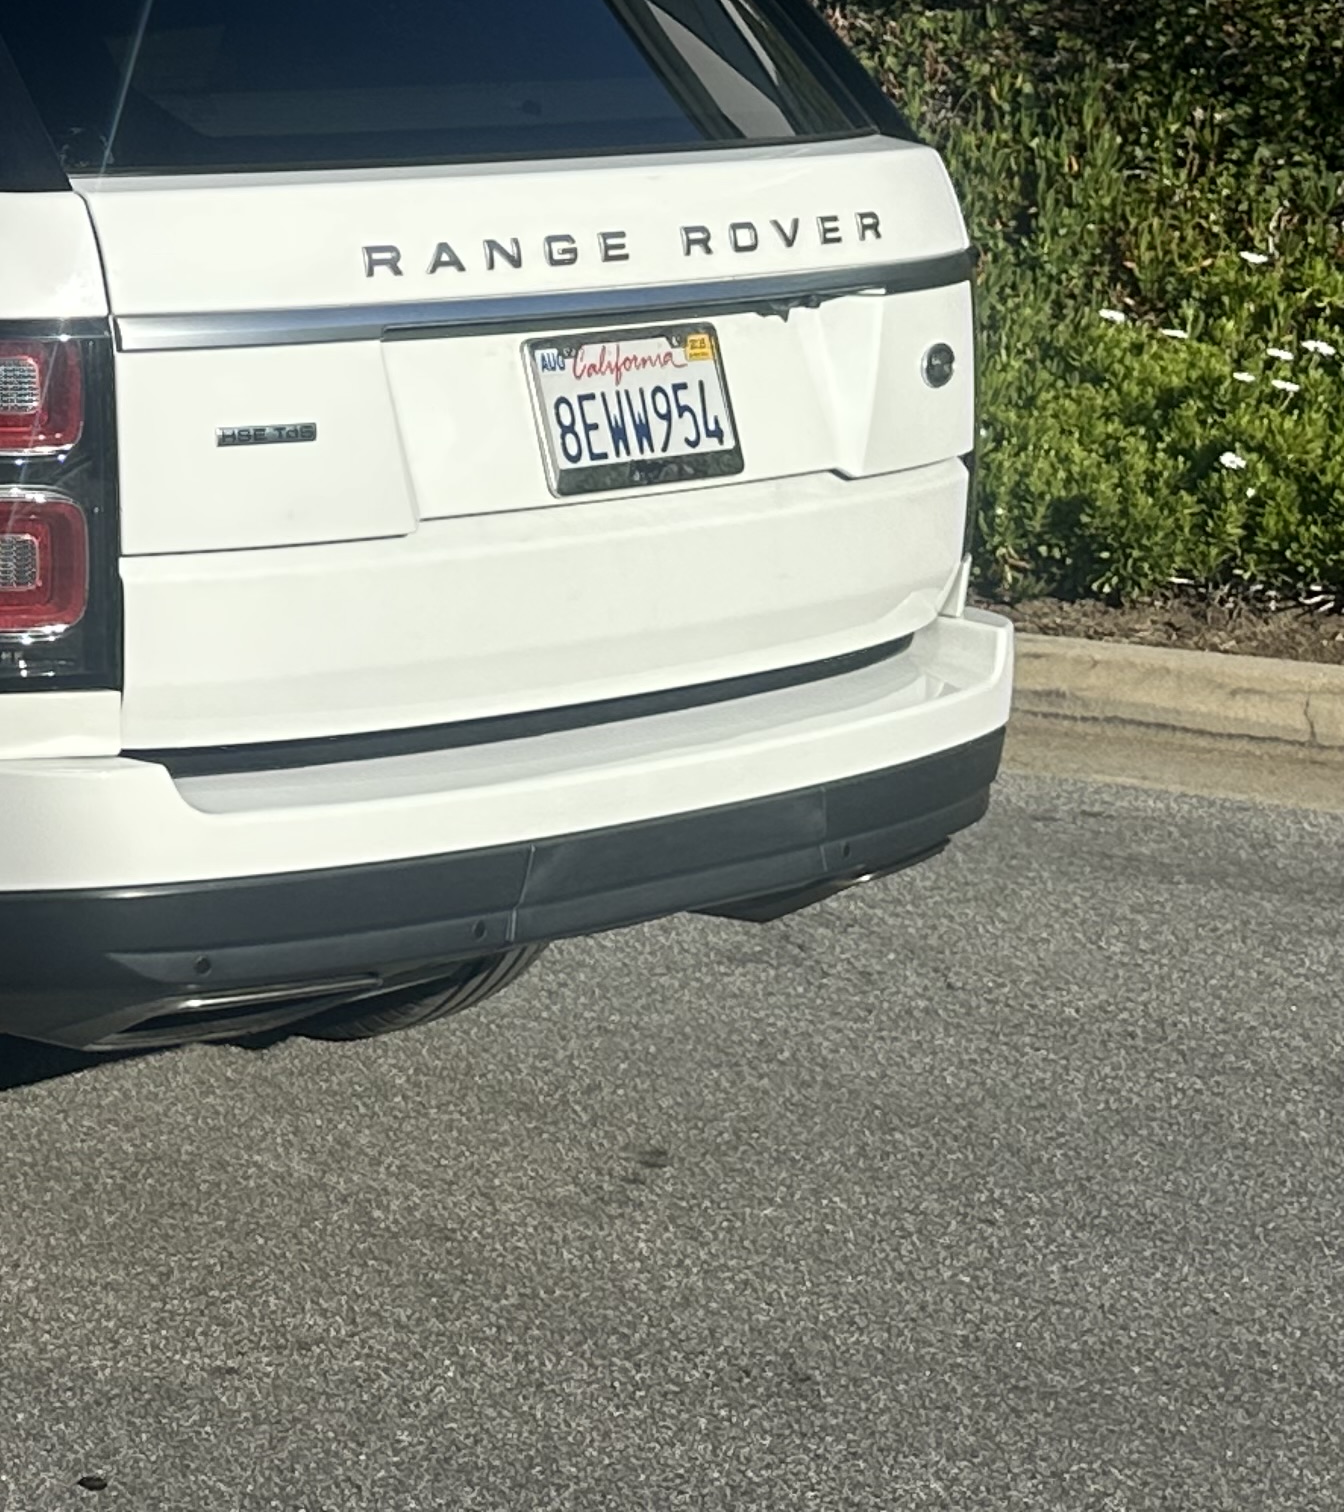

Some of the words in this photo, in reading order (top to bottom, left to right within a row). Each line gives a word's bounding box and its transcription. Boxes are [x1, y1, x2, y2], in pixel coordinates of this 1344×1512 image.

[361, 230, 631, 278] RANGE
[680, 210, 883, 257] ROVER
[541, 352, 566, 373] AUG
[572, 343, 688, 386] California
[221, 427, 267, 444] HSE
[553, 379, 725, 464] 8EWW954
